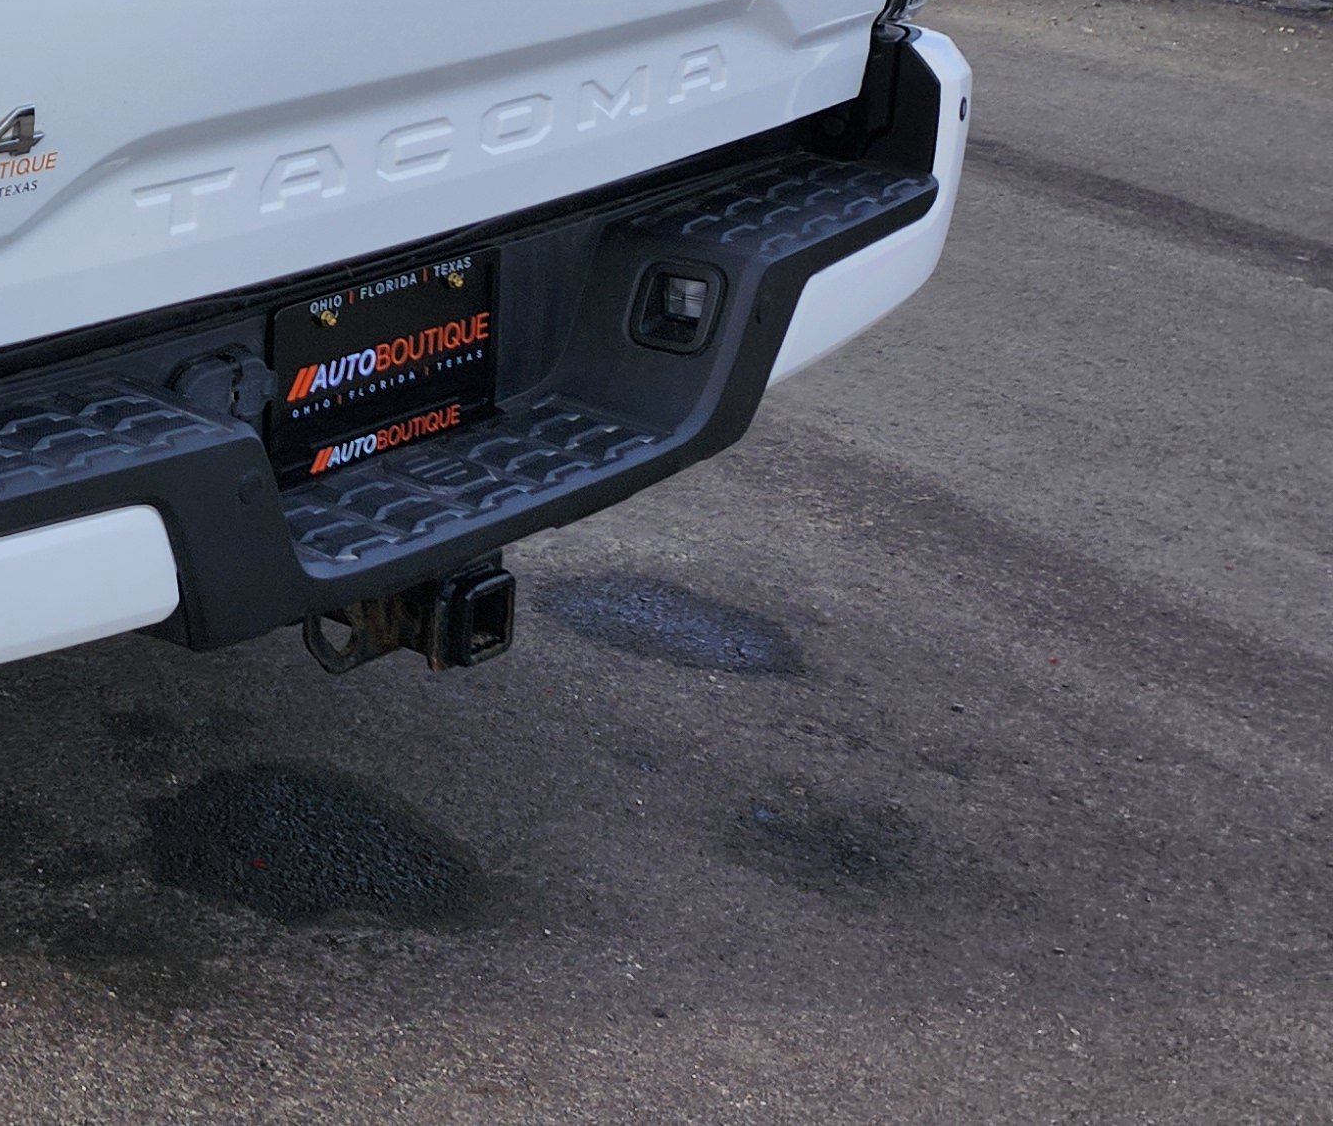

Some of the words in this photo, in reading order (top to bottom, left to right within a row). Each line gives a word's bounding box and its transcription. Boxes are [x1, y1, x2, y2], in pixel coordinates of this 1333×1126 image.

[132, 44, 728, 235] TACOMA
[309, 294, 344, 314] OHIO
[359, 272, 419, 301] FLORIDA
[433, 255, 473, 278] TEXAS
[291, 397, 332, 419] OHIO
[348, 370, 417, 400] FLORIDA
[436, 349, 484, 372] TEXAS
